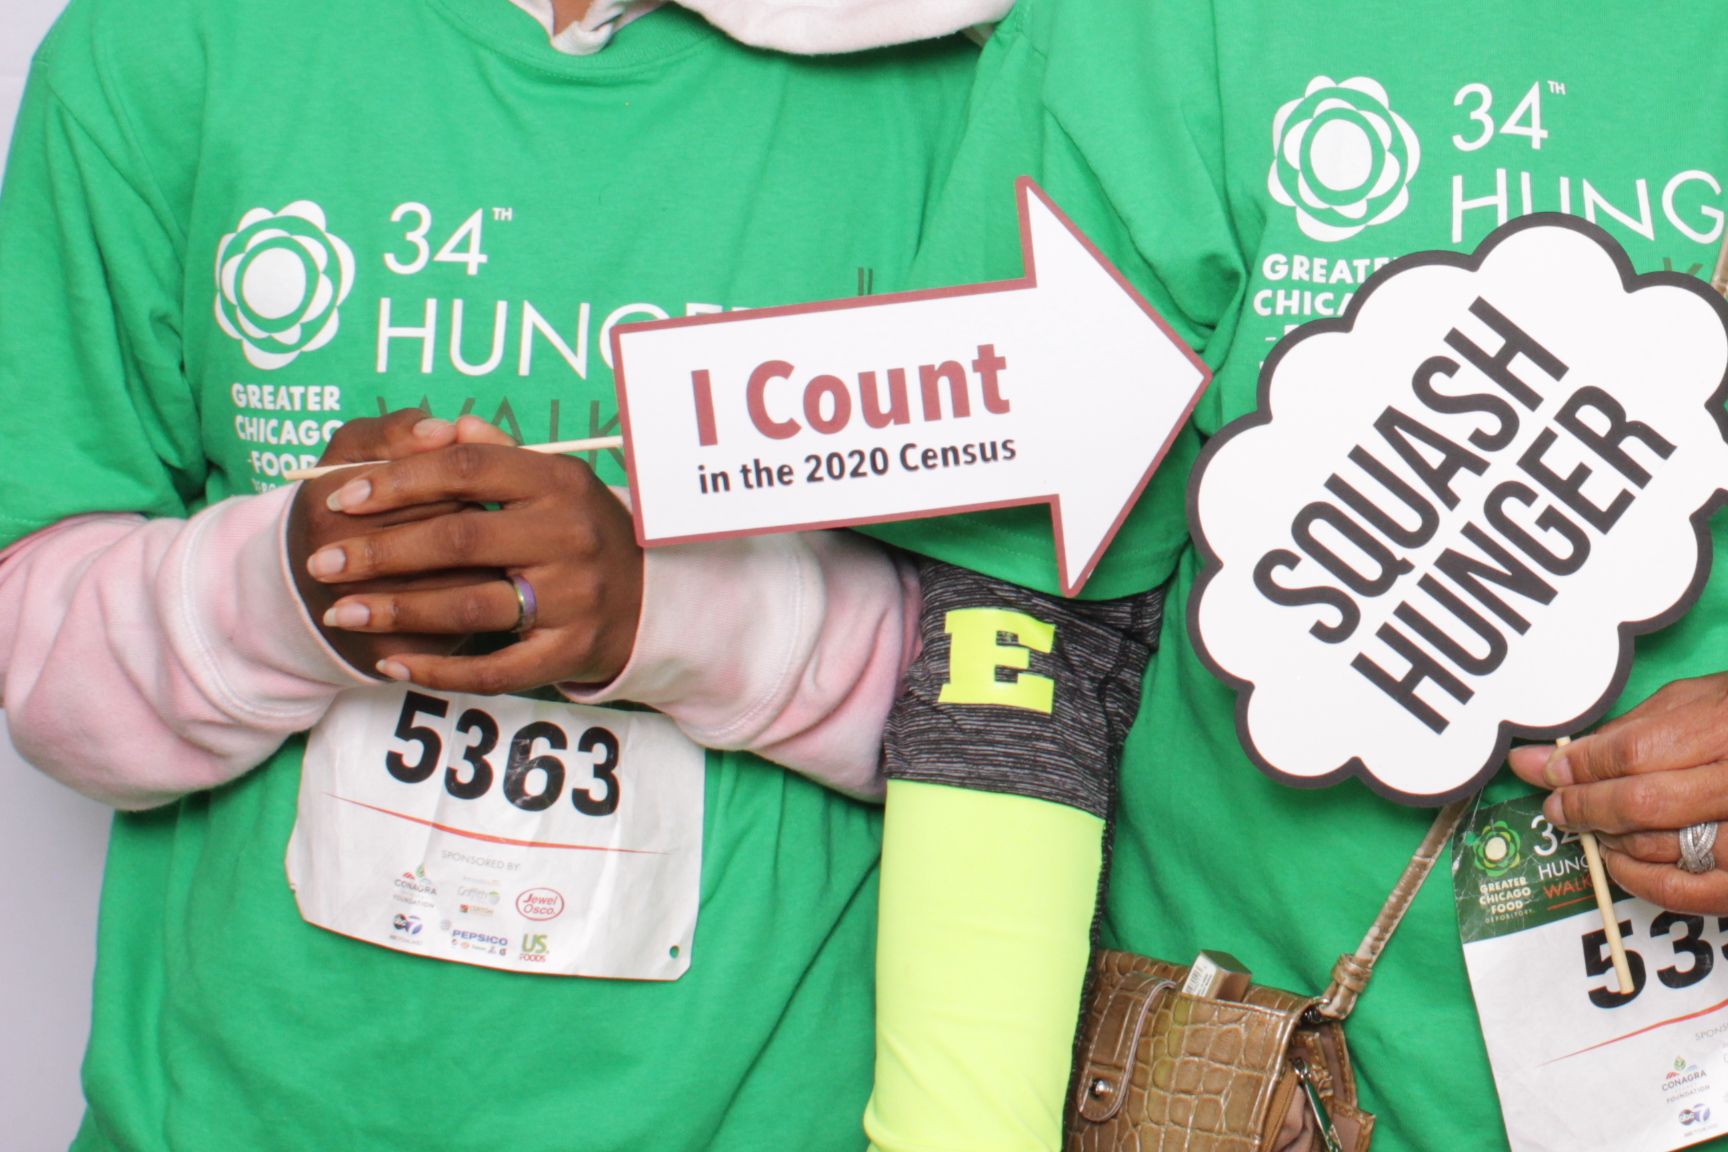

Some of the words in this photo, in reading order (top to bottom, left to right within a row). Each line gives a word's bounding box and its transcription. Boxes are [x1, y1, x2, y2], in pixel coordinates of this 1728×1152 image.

[1262, 253, 1399, 284] GREAT
[231, 383, 341, 411] GREATER
[691, 369, 718, 447] I
[745, 343, 1011, 441] Count
[698, 464, 731, 494] in
[740, 457, 794, 490] the
[805, 446, 889, 484] 2020
[899, 437, 1017, 472] Census
[1252, 294, 1570, 645] SQUASH
[1350, 384, 1678, 736] HUNGER
[937, 607, 1056, 714] E
[385, 690, 620, 816] 5363
[441, 850, 504, 869] SPONSORED
[394, 879, 437, 896] CONAGRA
[1479, 887, 1531, 905] CHICAGO
[1480, 877, 1526, 893] GREATER
[523, 893, 558, 905] Jewel
[452, 929, 508, 947] PEPSICO
[520, 953, 546, 962] FOODS
[1662, 1070, 1707, 1092] CONAGRA
[1666, 1085, 1710, 1103] FOUNDATION
